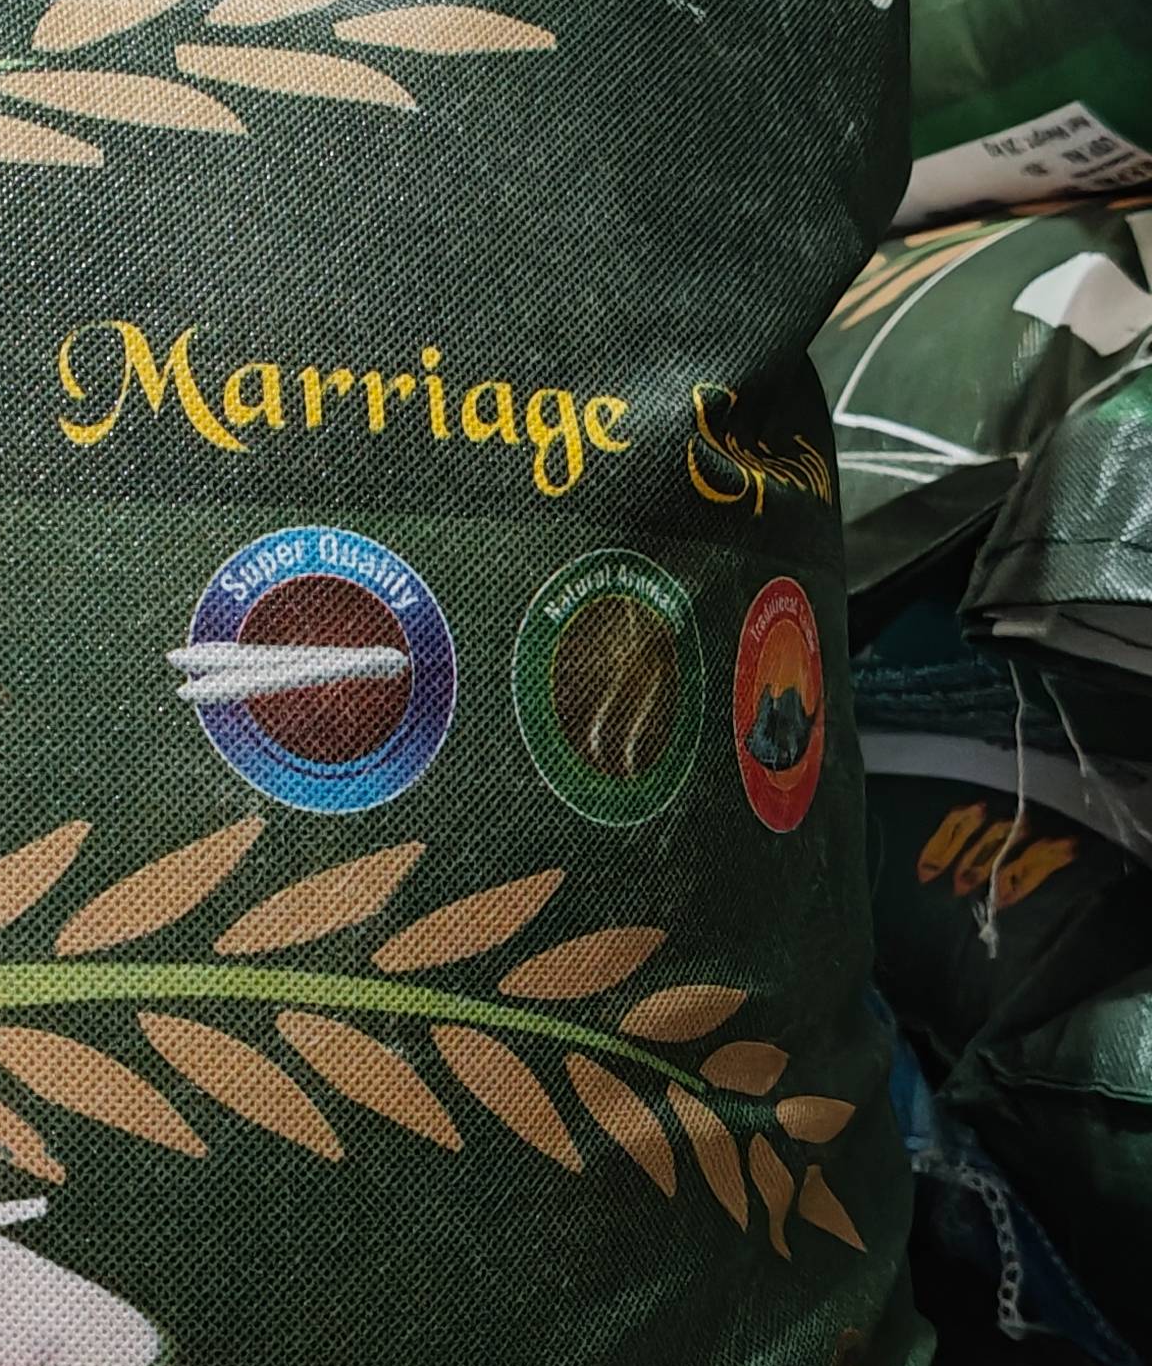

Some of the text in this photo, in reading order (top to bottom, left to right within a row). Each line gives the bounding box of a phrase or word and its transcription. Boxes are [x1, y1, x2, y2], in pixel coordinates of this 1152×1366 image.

[55, 318, 634, 497] Marriage
[220, 534, 419, 610] Super Quality
